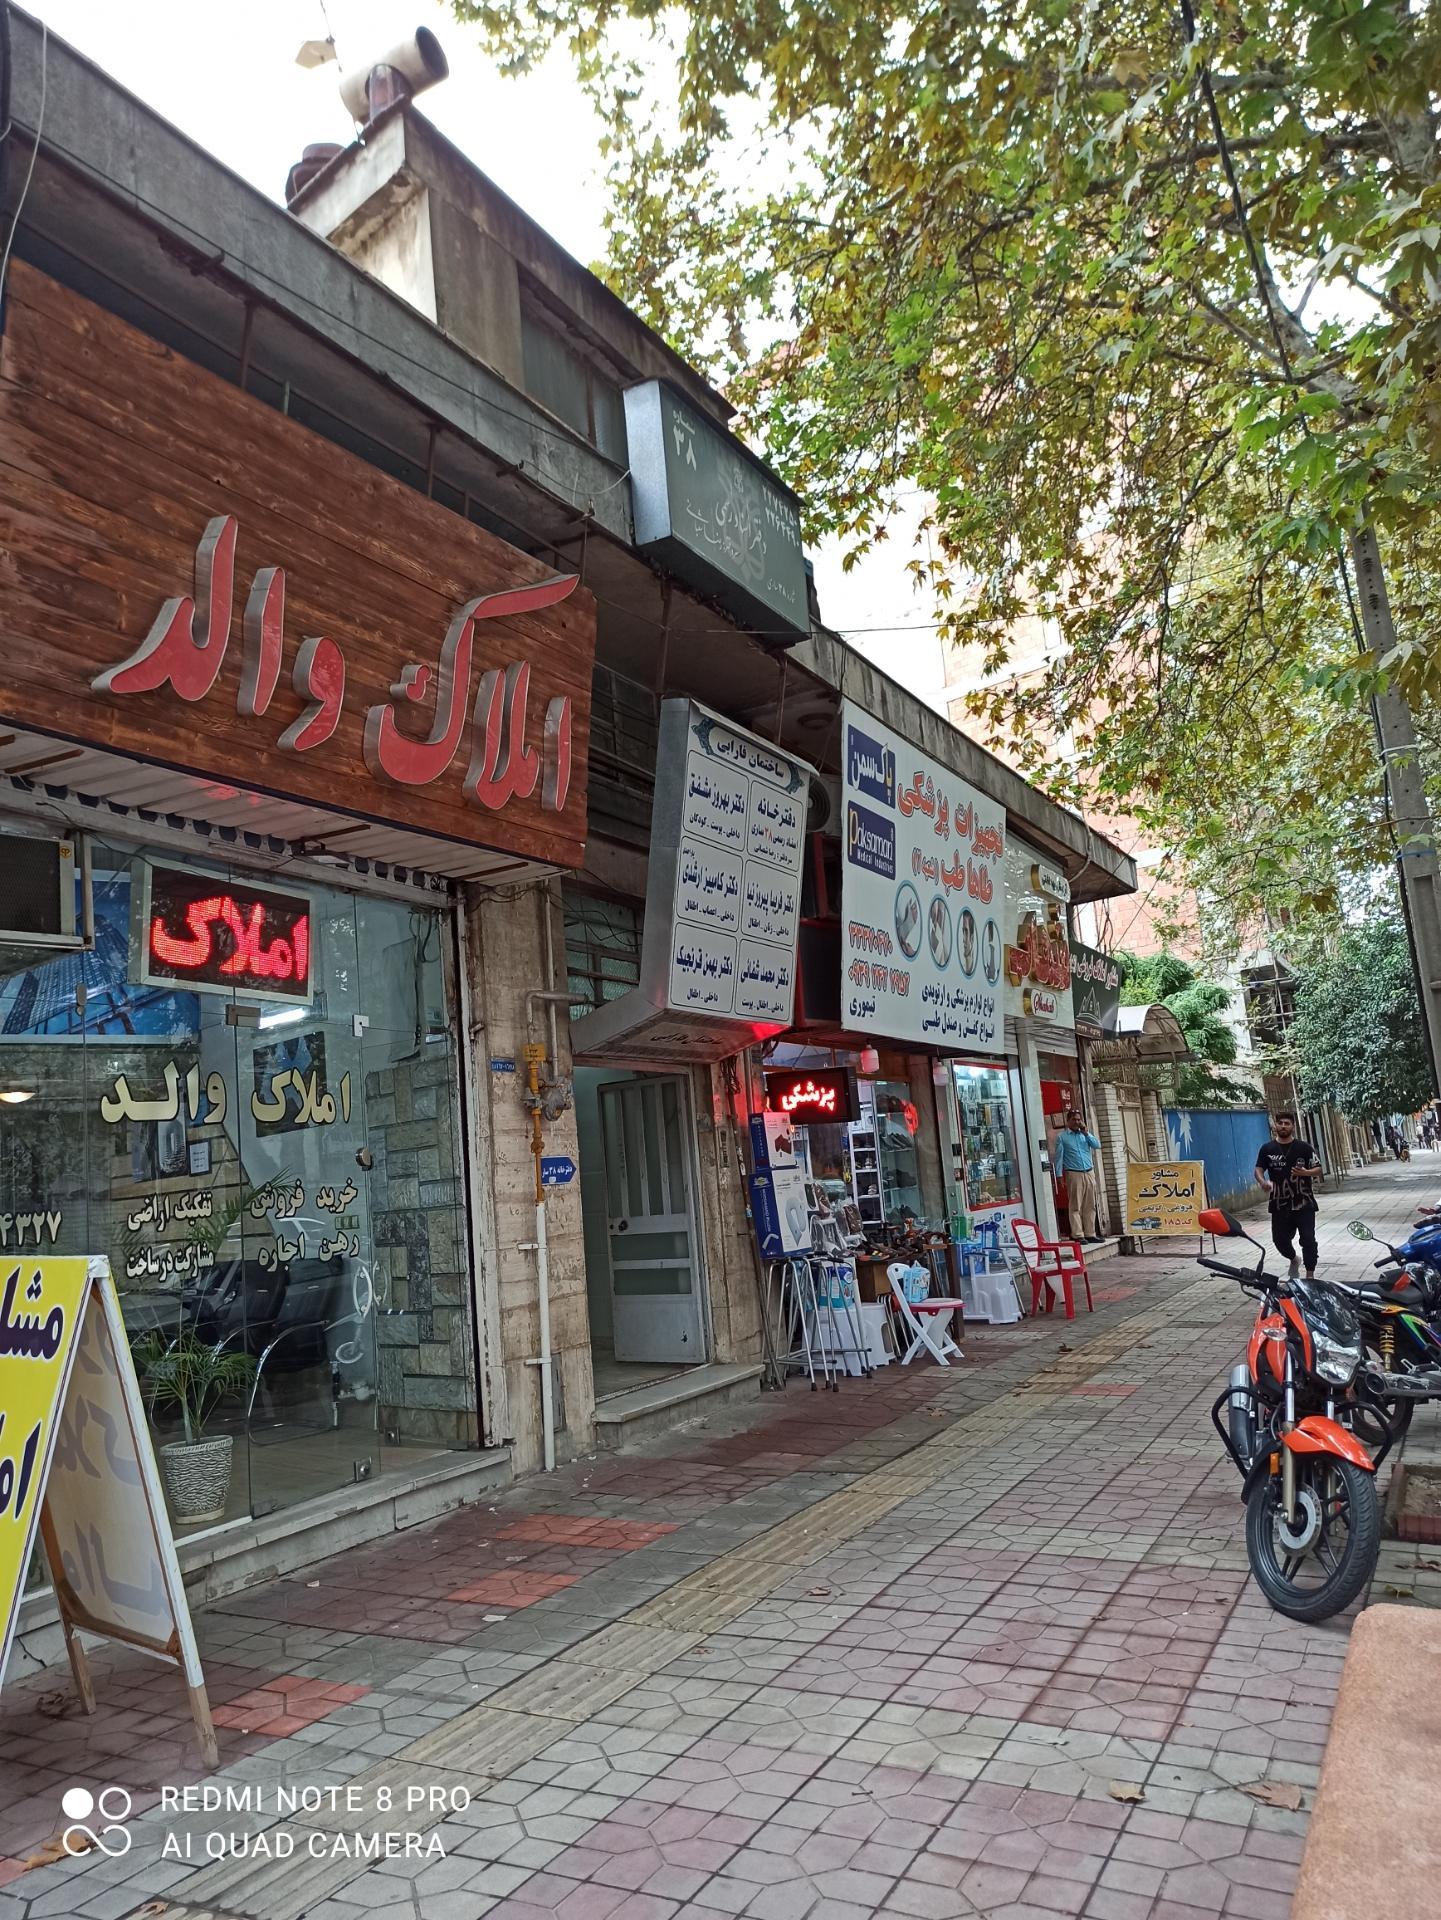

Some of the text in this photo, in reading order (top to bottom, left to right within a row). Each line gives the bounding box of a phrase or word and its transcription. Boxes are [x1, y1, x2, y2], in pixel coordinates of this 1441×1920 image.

[673, 425, 697, 471] ۳۸
[717, 740, 785, 778] ساختمان فارابی
[689, 773, 745, 815] دکتر بهروز مشفق
[726, 827, 741, 839] داخلی
[897, 770, 1004, 865] تجهیزات پزشکی
[849, 808, 893, 861] Paksaman
[724, 876, 739, 899] دکتر
[941, 848, 966, 897] طب
[967, 857, 993, 904] طاها
[720, 910, 735, 922] داخلی
[783, 894, 794, 916] دکتر
[152, 895, 308, 981] املاک
[718, 955, 733, 979] دکتر
[760, 966, 775, 983] محمد
[775, 967, 789, 990] دکتر
[849, 995, 876, 1018] تیموری
[950, 988, 970, 1013] پزشکی
[922, 1010, 941, 1032] طبی
[101, 1060, 352, 1124] املاک والد
[781, 1080, 836, 1111] پزشکی
[1139, 1182, 1196, 1198] املاک
[1152, 1169, 1180, 1180] مشاور
[127, 1191, 213, 1232] تفکیک اراضی
[250, 1177, 359, 1219] خرید فروش
[1164, 1218, 1181, 1226] ۱۸۵
[126, 1240, 215, 1282] مشارکت در ساخت
[257, 1230, 360, 1273] رهن اجاره
